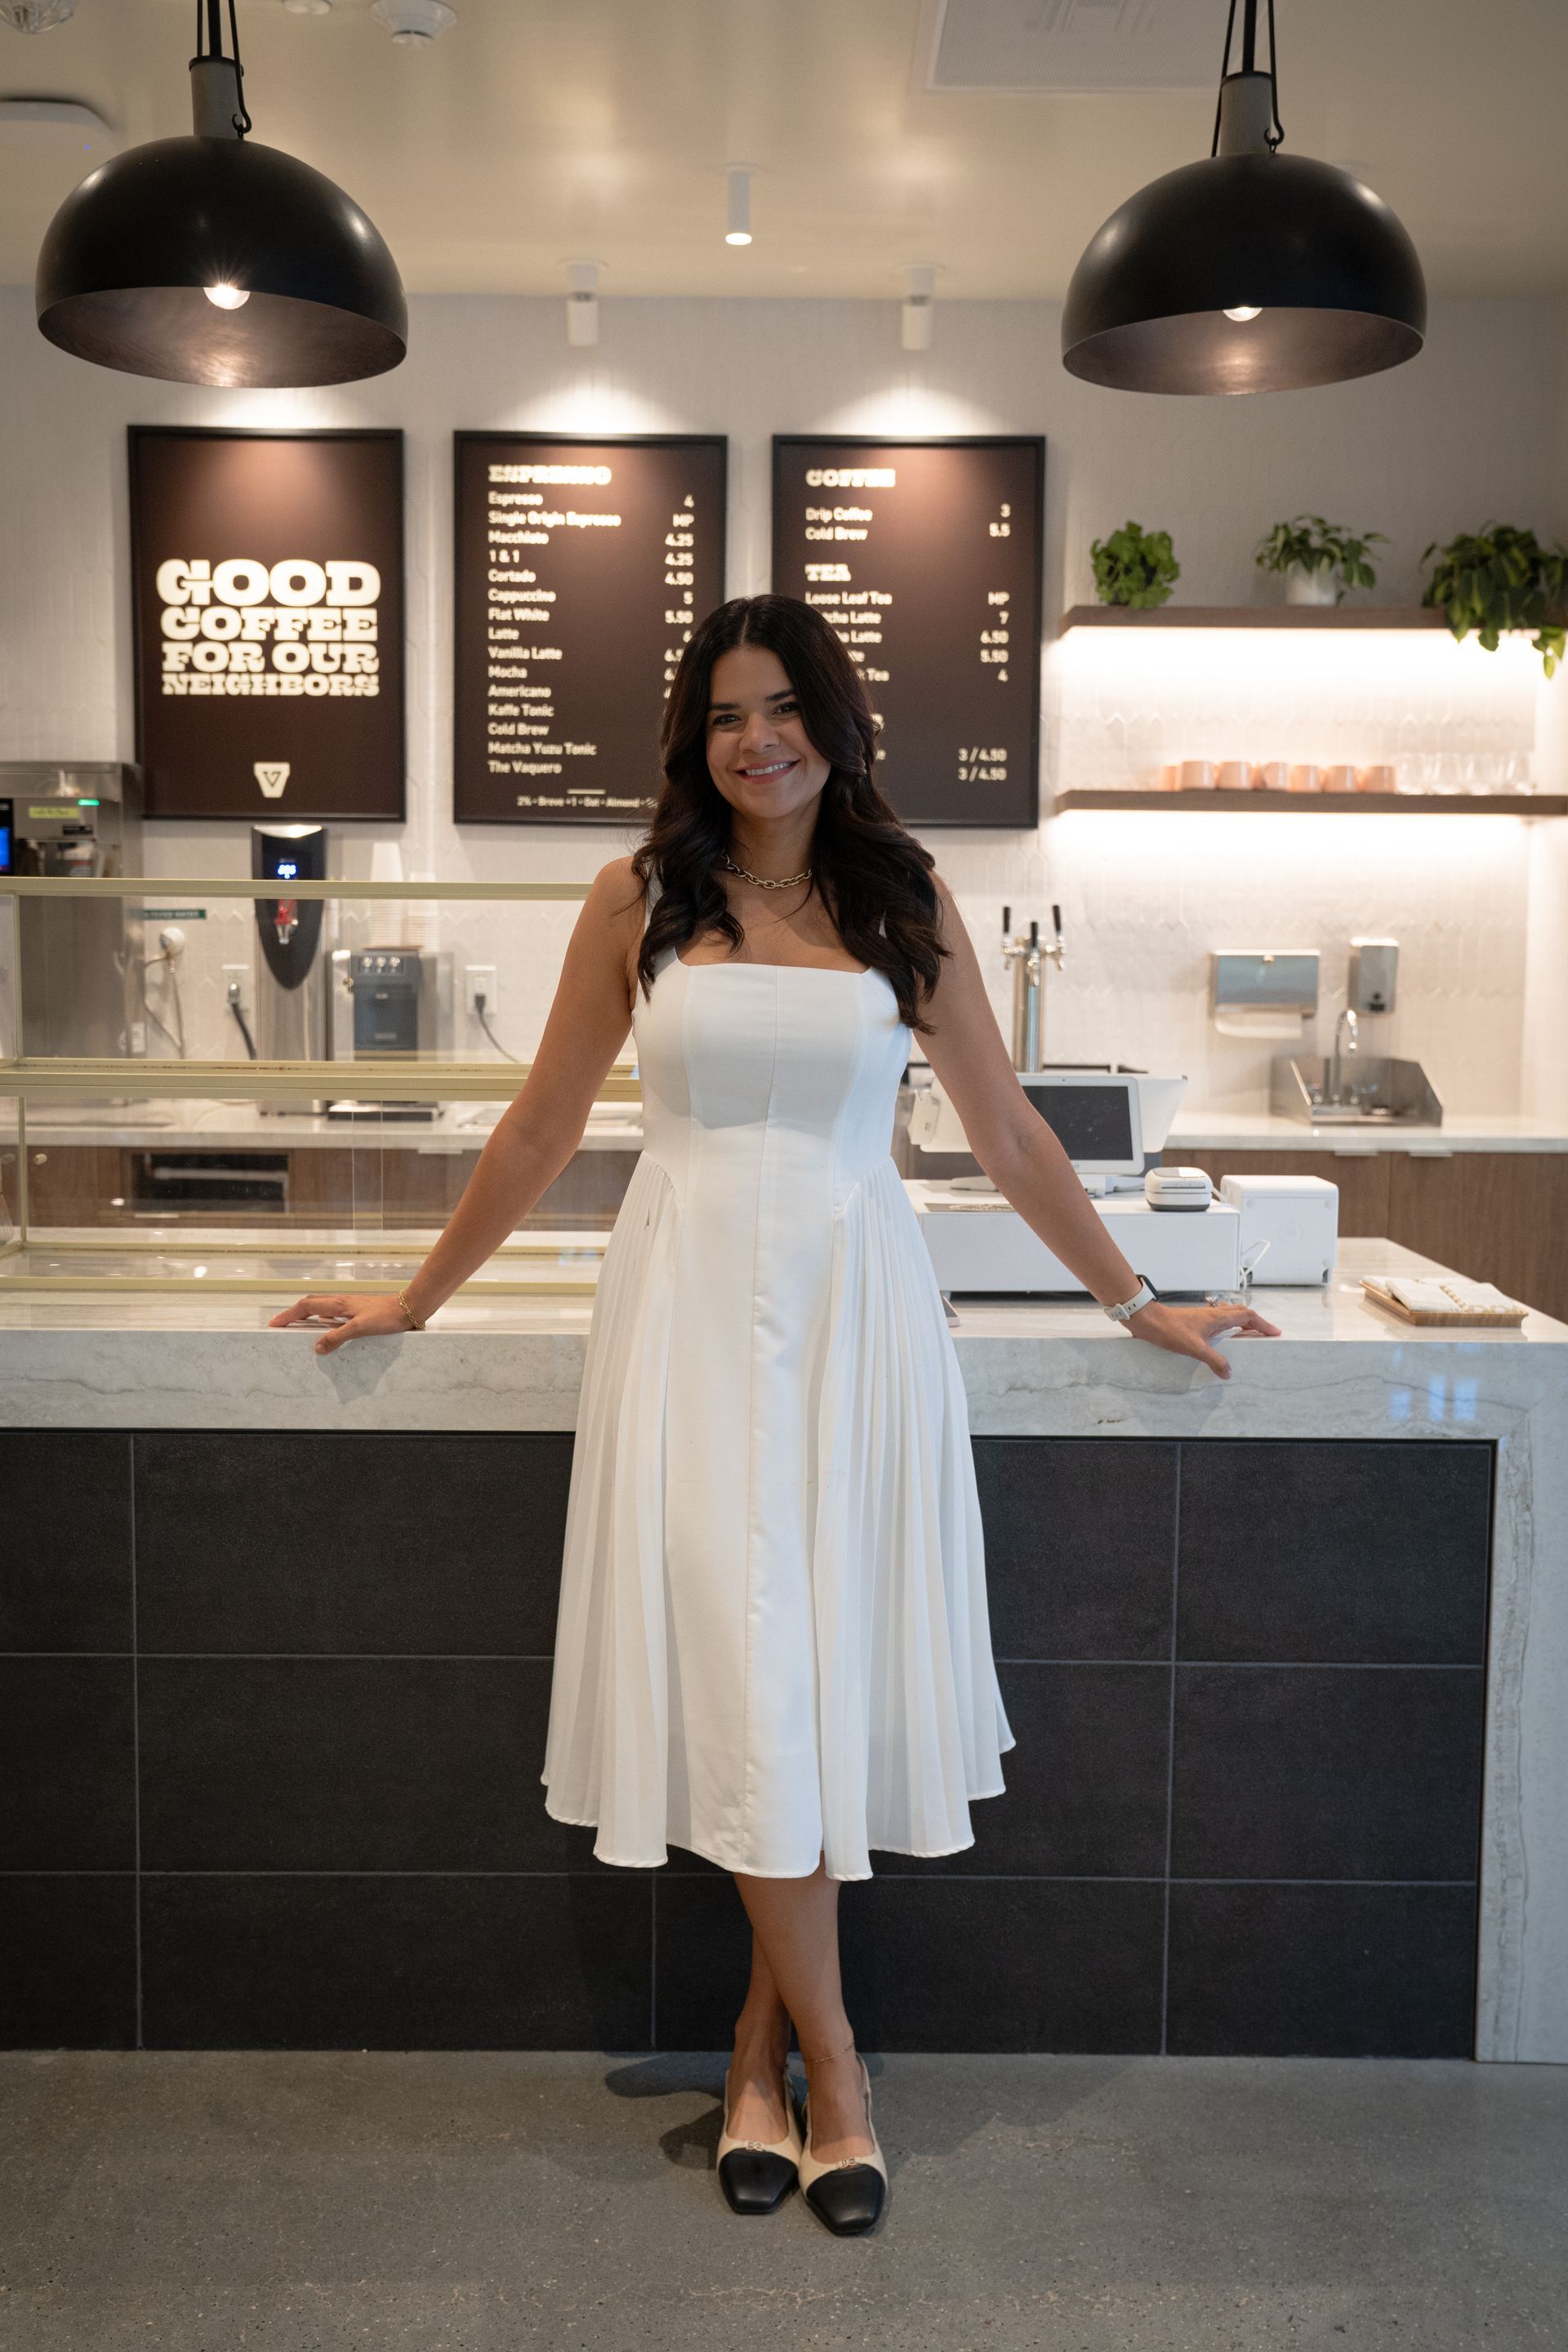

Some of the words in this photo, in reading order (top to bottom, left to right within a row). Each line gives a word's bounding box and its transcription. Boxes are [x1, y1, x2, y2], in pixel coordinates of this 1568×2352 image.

[805, 468, 896, 488] COFFEE
[488, 491, 543, 507] Espresso
[684, 494, 694, 508] 4
[805, 506, 833, 523] Drip
[833, 506, 873, 522] Coffee
[1000, 503, 1011, 518] 3
[488, 510, 527, 527] Single
[527, 510, 565, 528] Origin
[566, 510, 621, 528] Espresso
[488, 529, 549, 545] Macchiato
[805, 526, 834, 541] Cold
[834, 526, 868, 541] Brew
[989, 523, 1011, 537] 5.5
[665, 532, 694, 547] 4.25
[488, 549, 497, 563] 1
[498, 548, 510, 563] &
[512, 549, 520, 563] 1
[665, 552, 694, 567] 4.25
[488, 568, 537, 583] Cortado
[665, 571, 694, 586] 4.50
[804, 564, 852, 581] TEA
[156, 559, 381, 607] GOOD
[488, 588, 556, 604] Cappuccino
[683, 590, 693, 604] 5
[805, 590, 841, 605] Loose
[841, 590, 869, 605] Leaf
[868, 590, 893, 605] Tea
[488, 607, 513, 621] Flat
[513, 608, 550, 621] White
[665, 610, 693, 624] 5.50
[849, 610, 882, 625] Latte
[999, 610, 1009, 625] 7
[160, 607, 378, 642] COFFEE
[488, 626, 519, 640] Latte
[850, 630, 882, 644] Latte
[980, 630, 1009, 644] 6.50
[162, 641, 265, 674] FOR
[271, 641, 380, 674] OUR
[488, 646, 530, 660] Vanilla
[531, 646, 563, 660] Latte
[980, 649, 1009, 663] 5.50
[488, 665, 528, 679] Mocha
[866, 668, 889, 682] Tea
[998, 669, 1009, 682] 4
[162, 673, 380, 697] NEIGHBORS
[488, 684, 551, 698] Americano
[521, 703, 555, 717] Tonic
[488, 722, 516, 736] Cold
[517, 722, 550, 736] Brew
[488, 742, 531, 755] Matcha
[532, 742, 563, 755] Yuzu
[564, 742, 597, 755] Tonic
[488, 760, 511, 773] The
[512, 760, 562, 776] Vaquero
